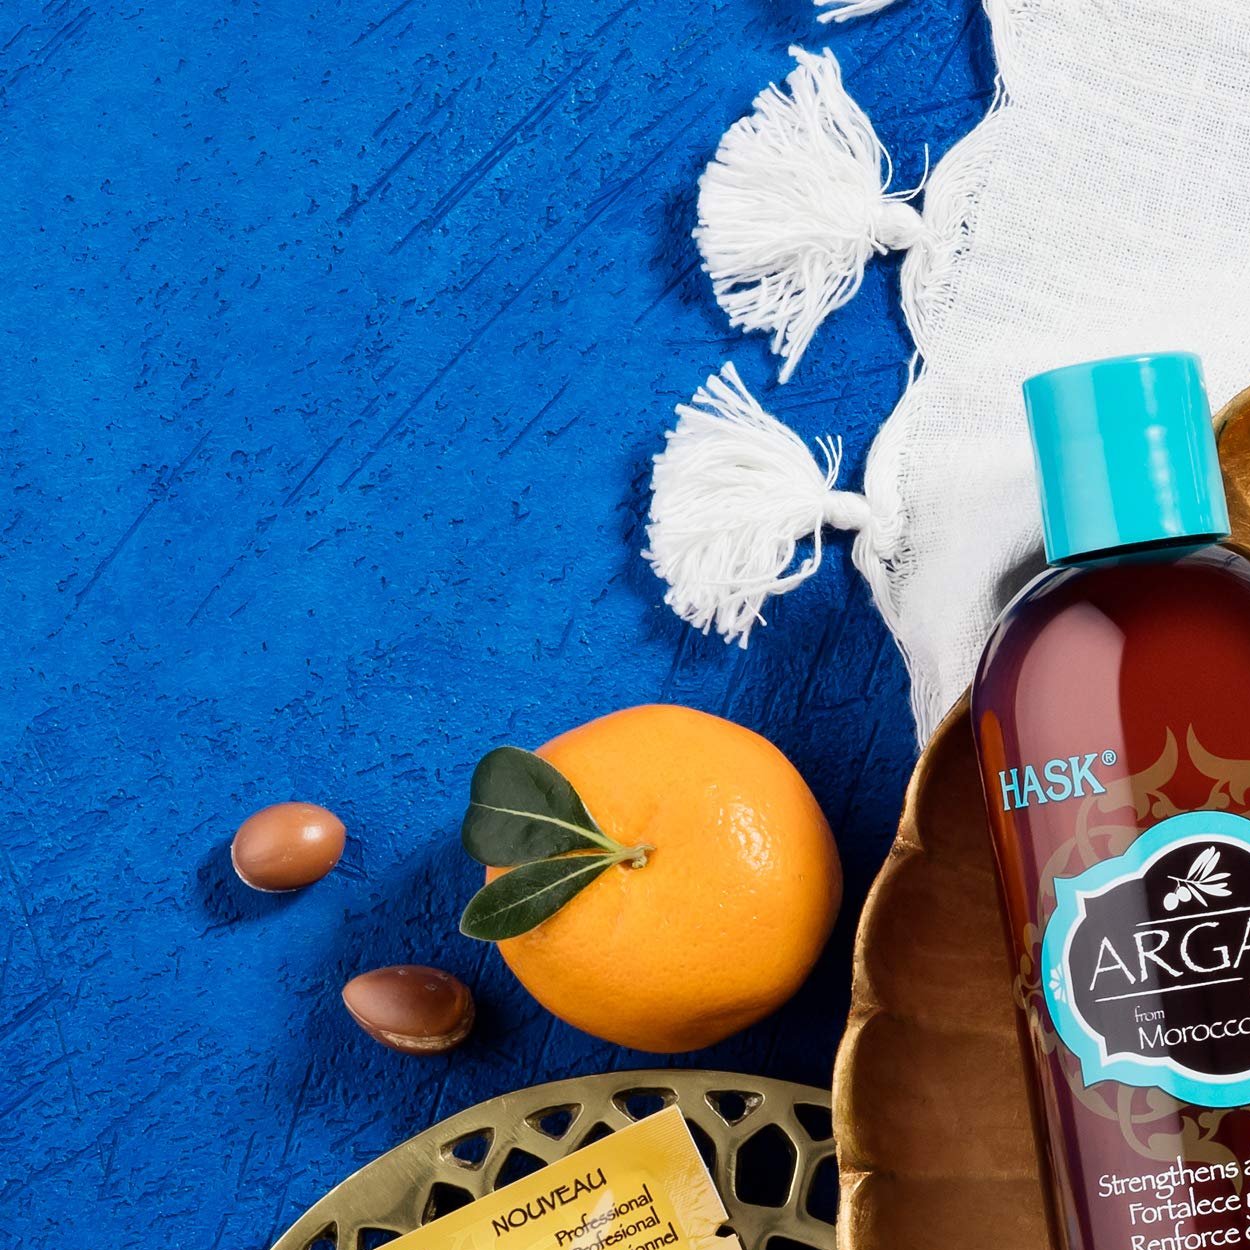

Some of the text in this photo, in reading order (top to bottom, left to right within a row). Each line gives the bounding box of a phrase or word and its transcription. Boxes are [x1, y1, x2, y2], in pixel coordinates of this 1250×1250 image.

[1135, 1006, 1165, 1022] from
[1099, 1156, 1239, 1199] Strengthens
[492, 1168, 607, 1237] NOUVEAU
[554, 1184, 653, 1247] Professional
[1130, 1187, 1241, 1224] Fortalece
